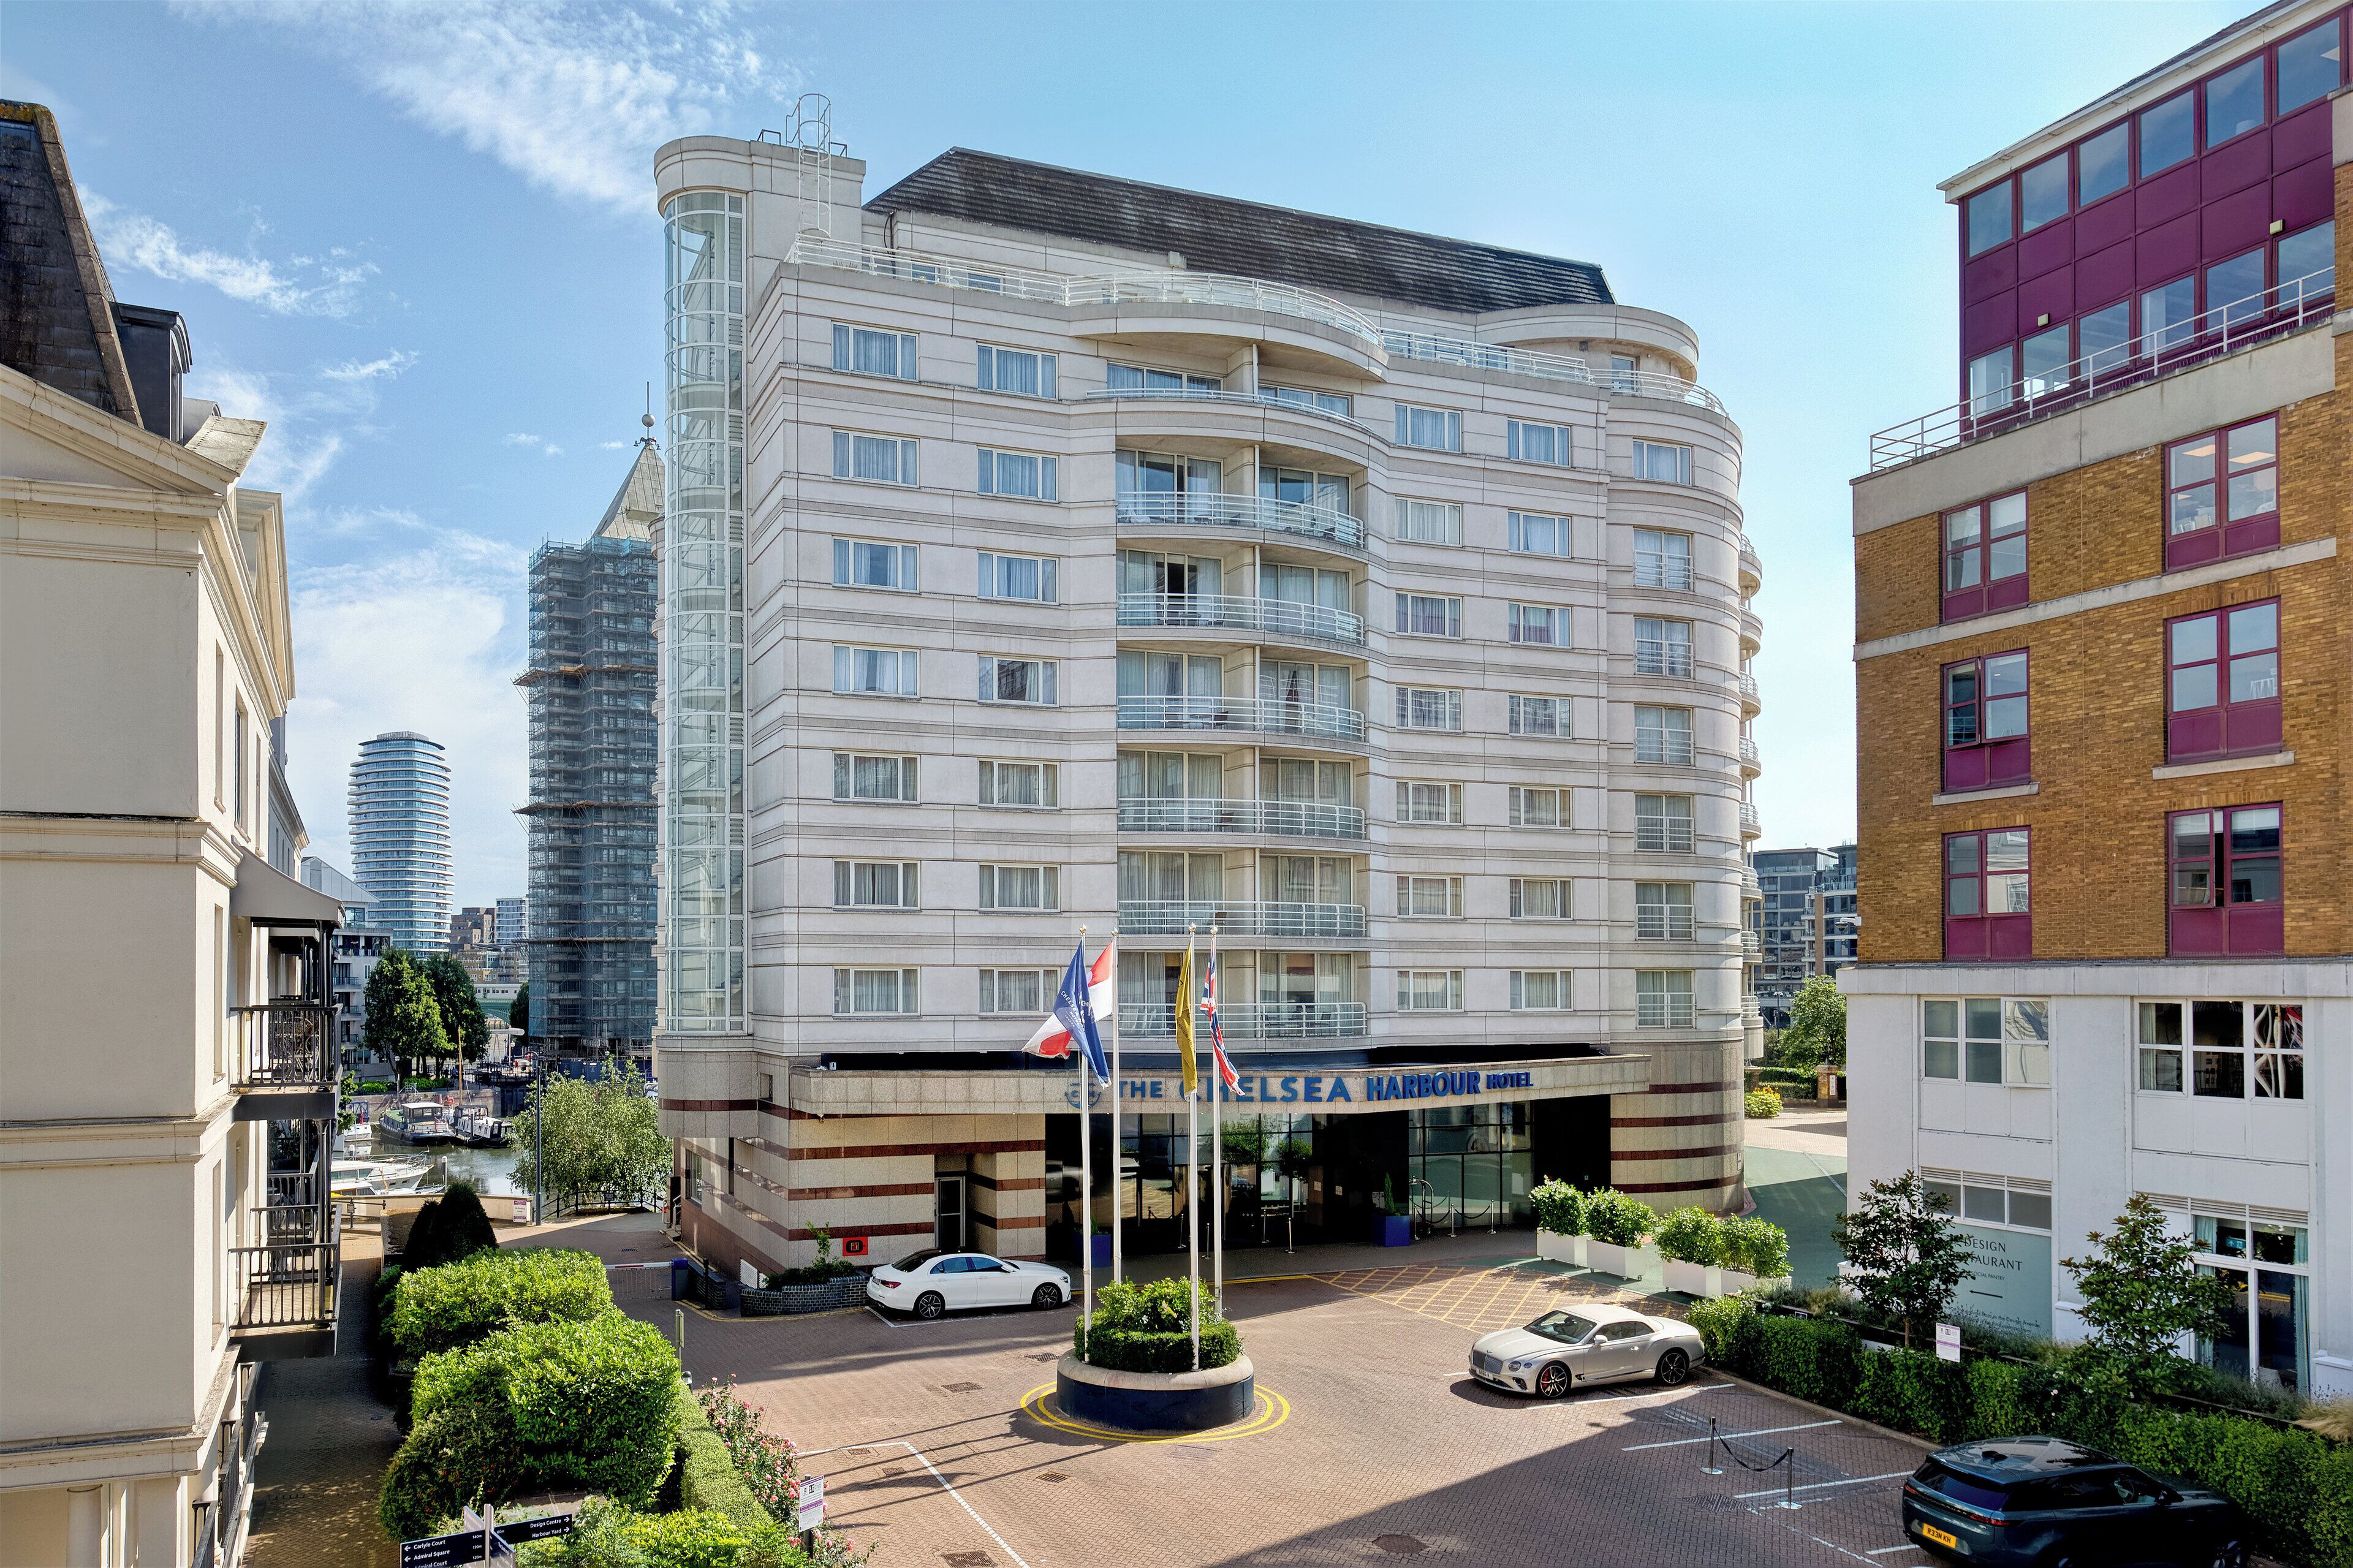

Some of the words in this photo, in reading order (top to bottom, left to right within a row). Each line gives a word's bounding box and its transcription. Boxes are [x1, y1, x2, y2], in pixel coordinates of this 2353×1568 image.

[1061, 990, 1078, 1017] CHELSEA
[1119, 1081, 1162, 1097] THE
[1367, 1071, 1481, 1101] HARBOUR
[1487, 1071, 1533, 1089] HOTEL
[1965, 1237, 2006, 1253] DESIGN
[1943, 1535, 1952, 1544] KH
[414, 1552, 433, 1561] Admiral
